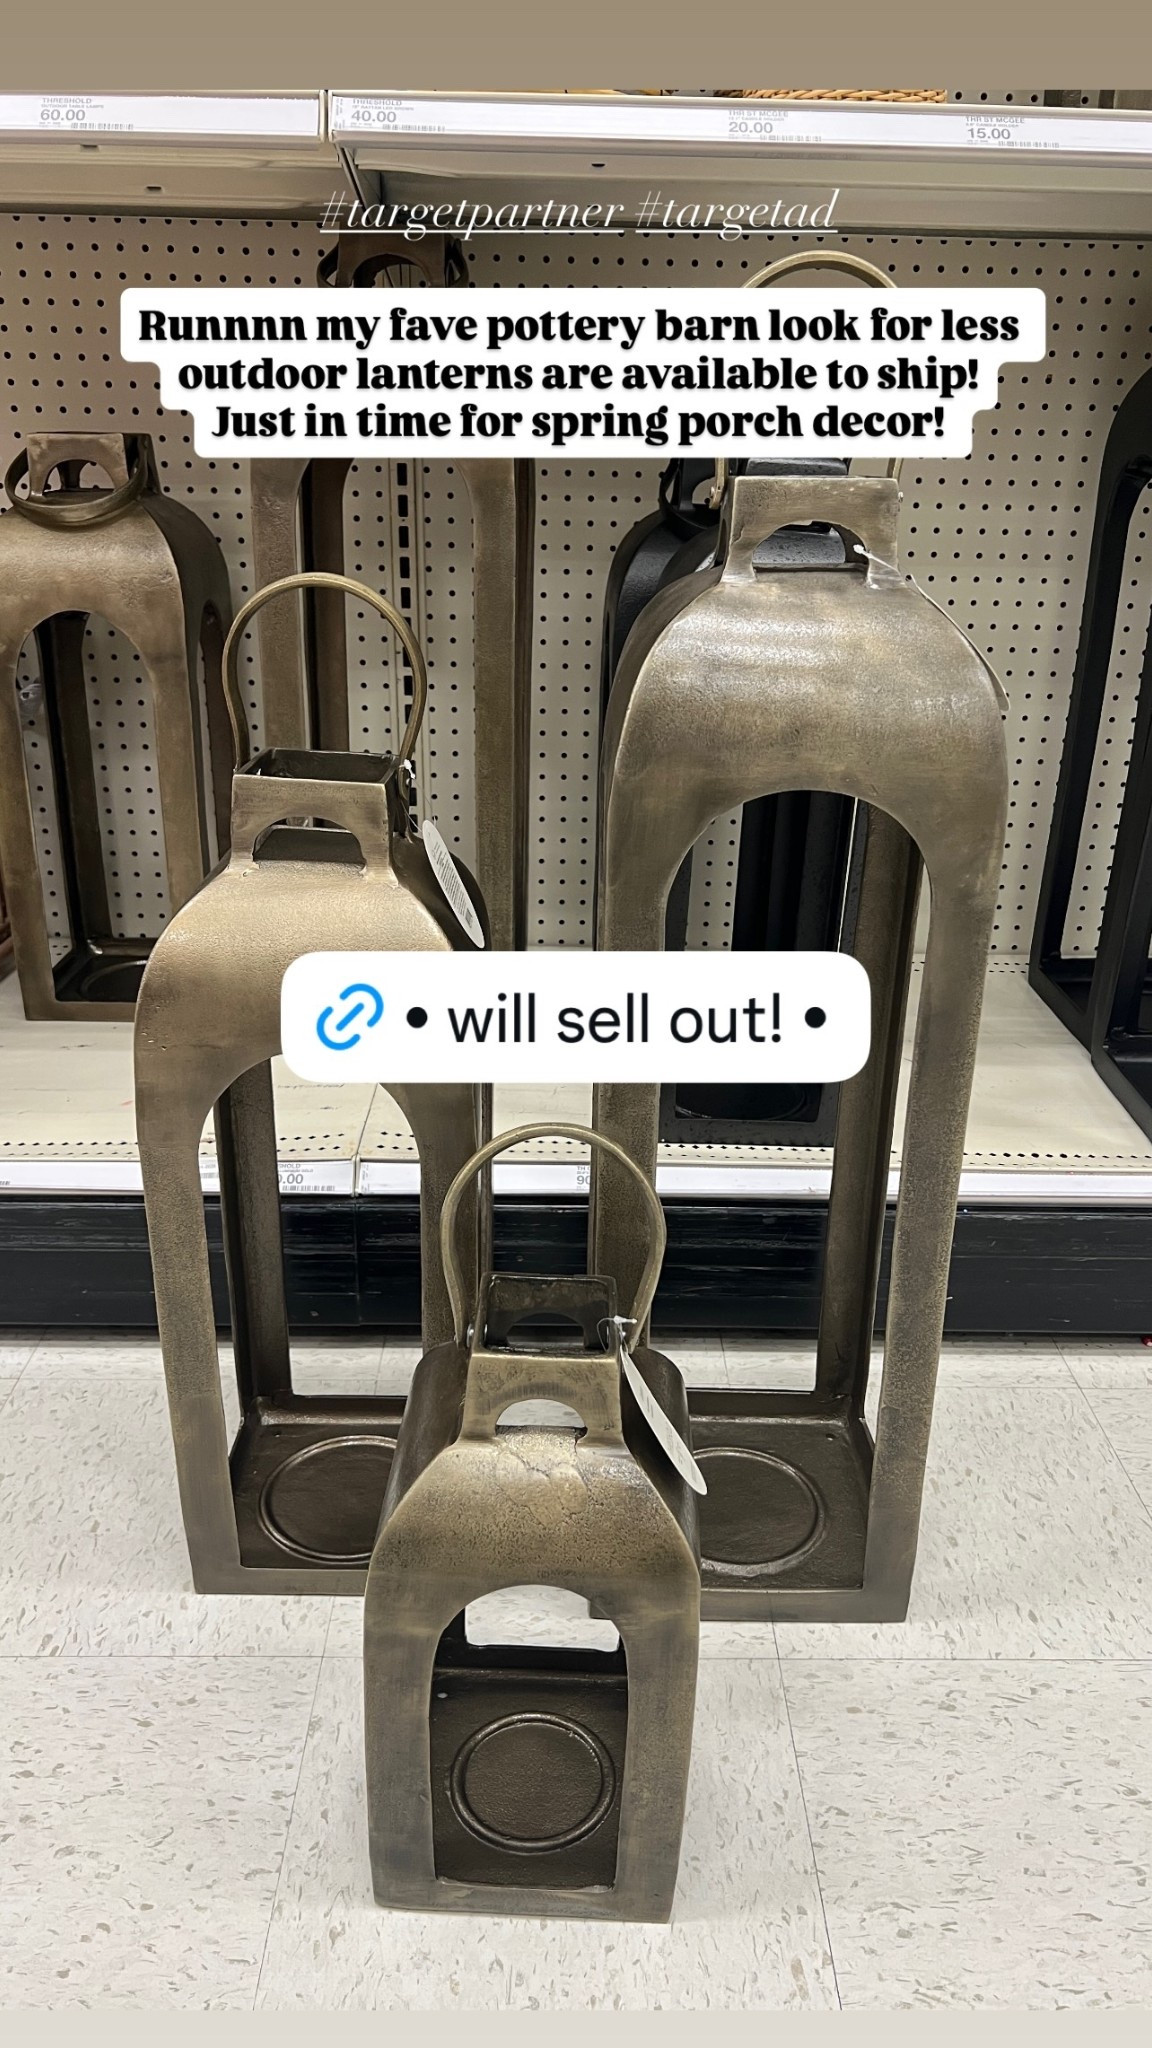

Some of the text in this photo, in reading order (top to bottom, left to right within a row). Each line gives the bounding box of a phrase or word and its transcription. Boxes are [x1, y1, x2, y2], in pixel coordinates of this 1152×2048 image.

[40, 109, 86, 121] 60.00
[351, 110, 397, 122] 40.00
[729, 121, 773, 133] 20.00
[967, 127, 1011, 139] 15.00
